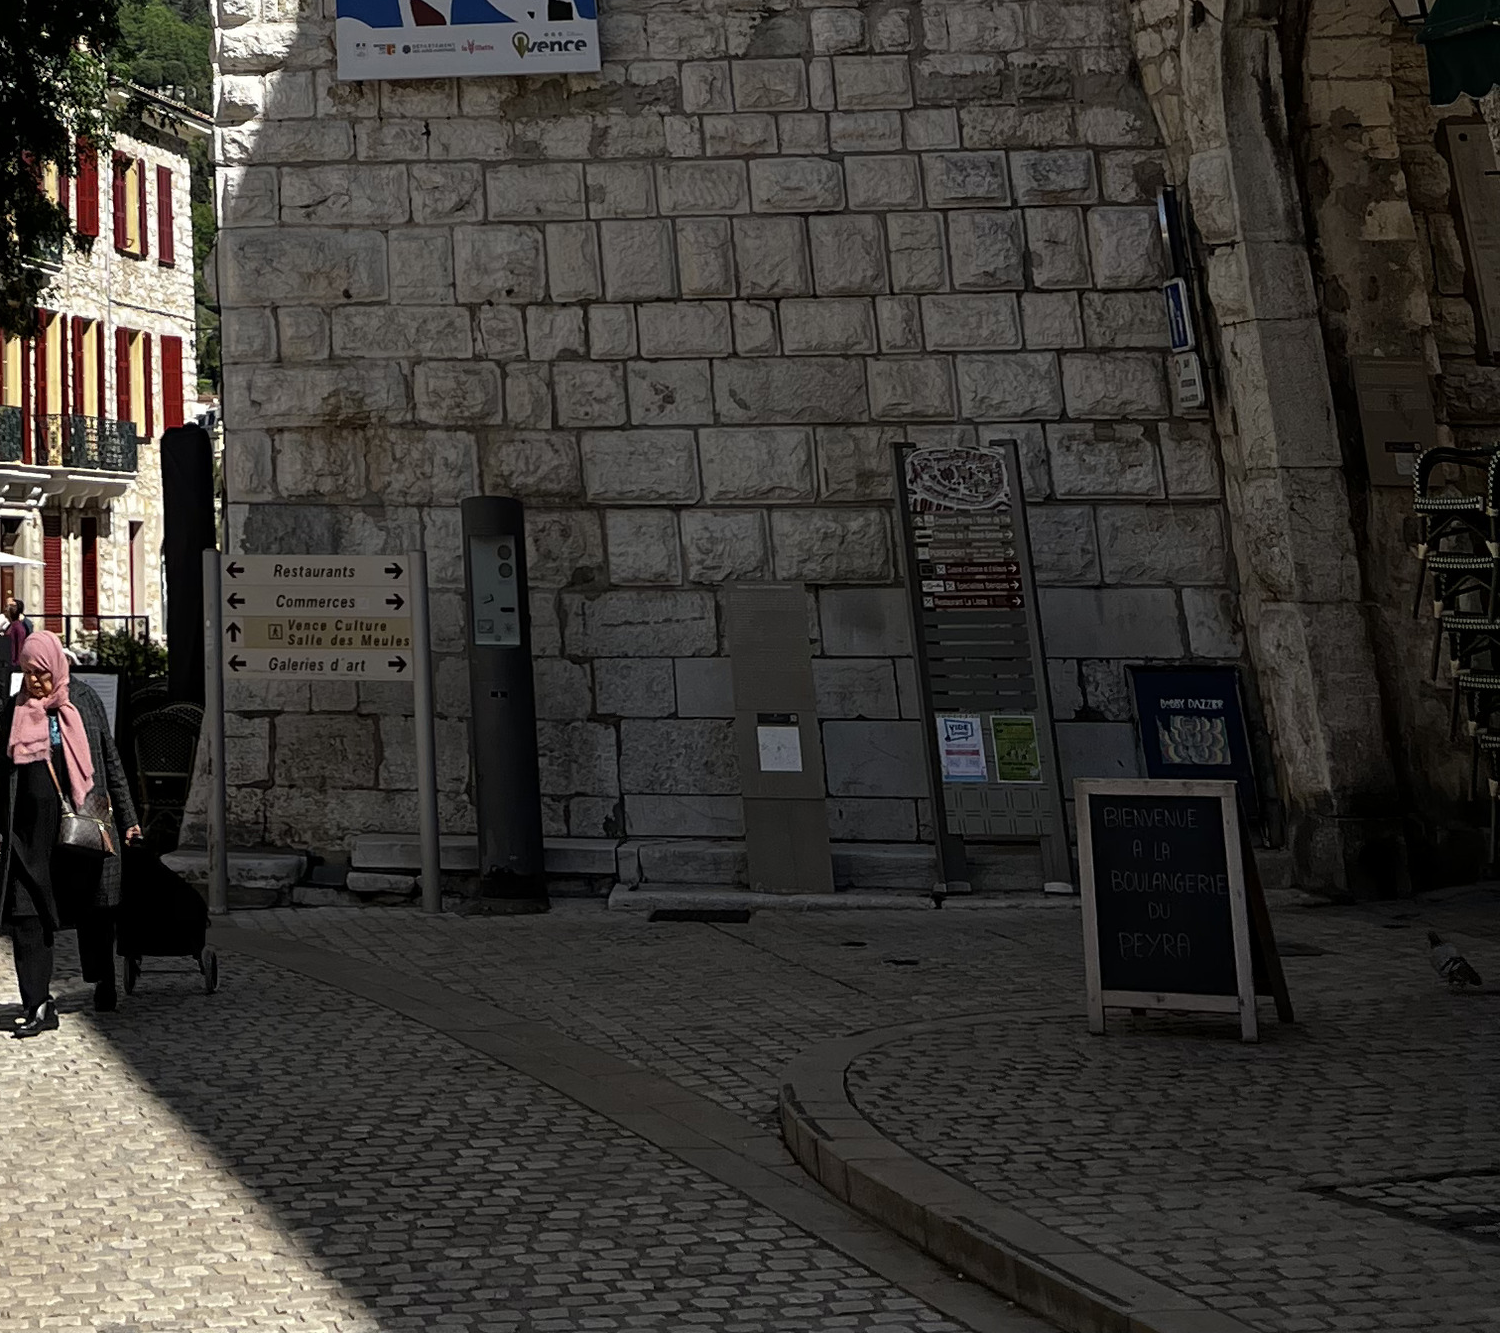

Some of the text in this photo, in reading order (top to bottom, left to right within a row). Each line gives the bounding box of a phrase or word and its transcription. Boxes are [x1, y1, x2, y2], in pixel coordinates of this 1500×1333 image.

[528, 39, 587, 53] vence
[273, 564, 356, 578] Restaurants
[276, 595, 356, 608] Commerces
[287, 619, 387, 631] Vence Culture
[287, 634, 410, 647] Salle des Meules
[268, 657, 324, 672] Galeries
[1103, 806, 1199, 828] BIENVENUE
[1132, 838, 1172, 861] A LA
[1110, 870, 1228, 895] BOULANGERIE
[1148, 901, 1172, 920] DU
[1118, 931, 1192, 961] PEYRA
